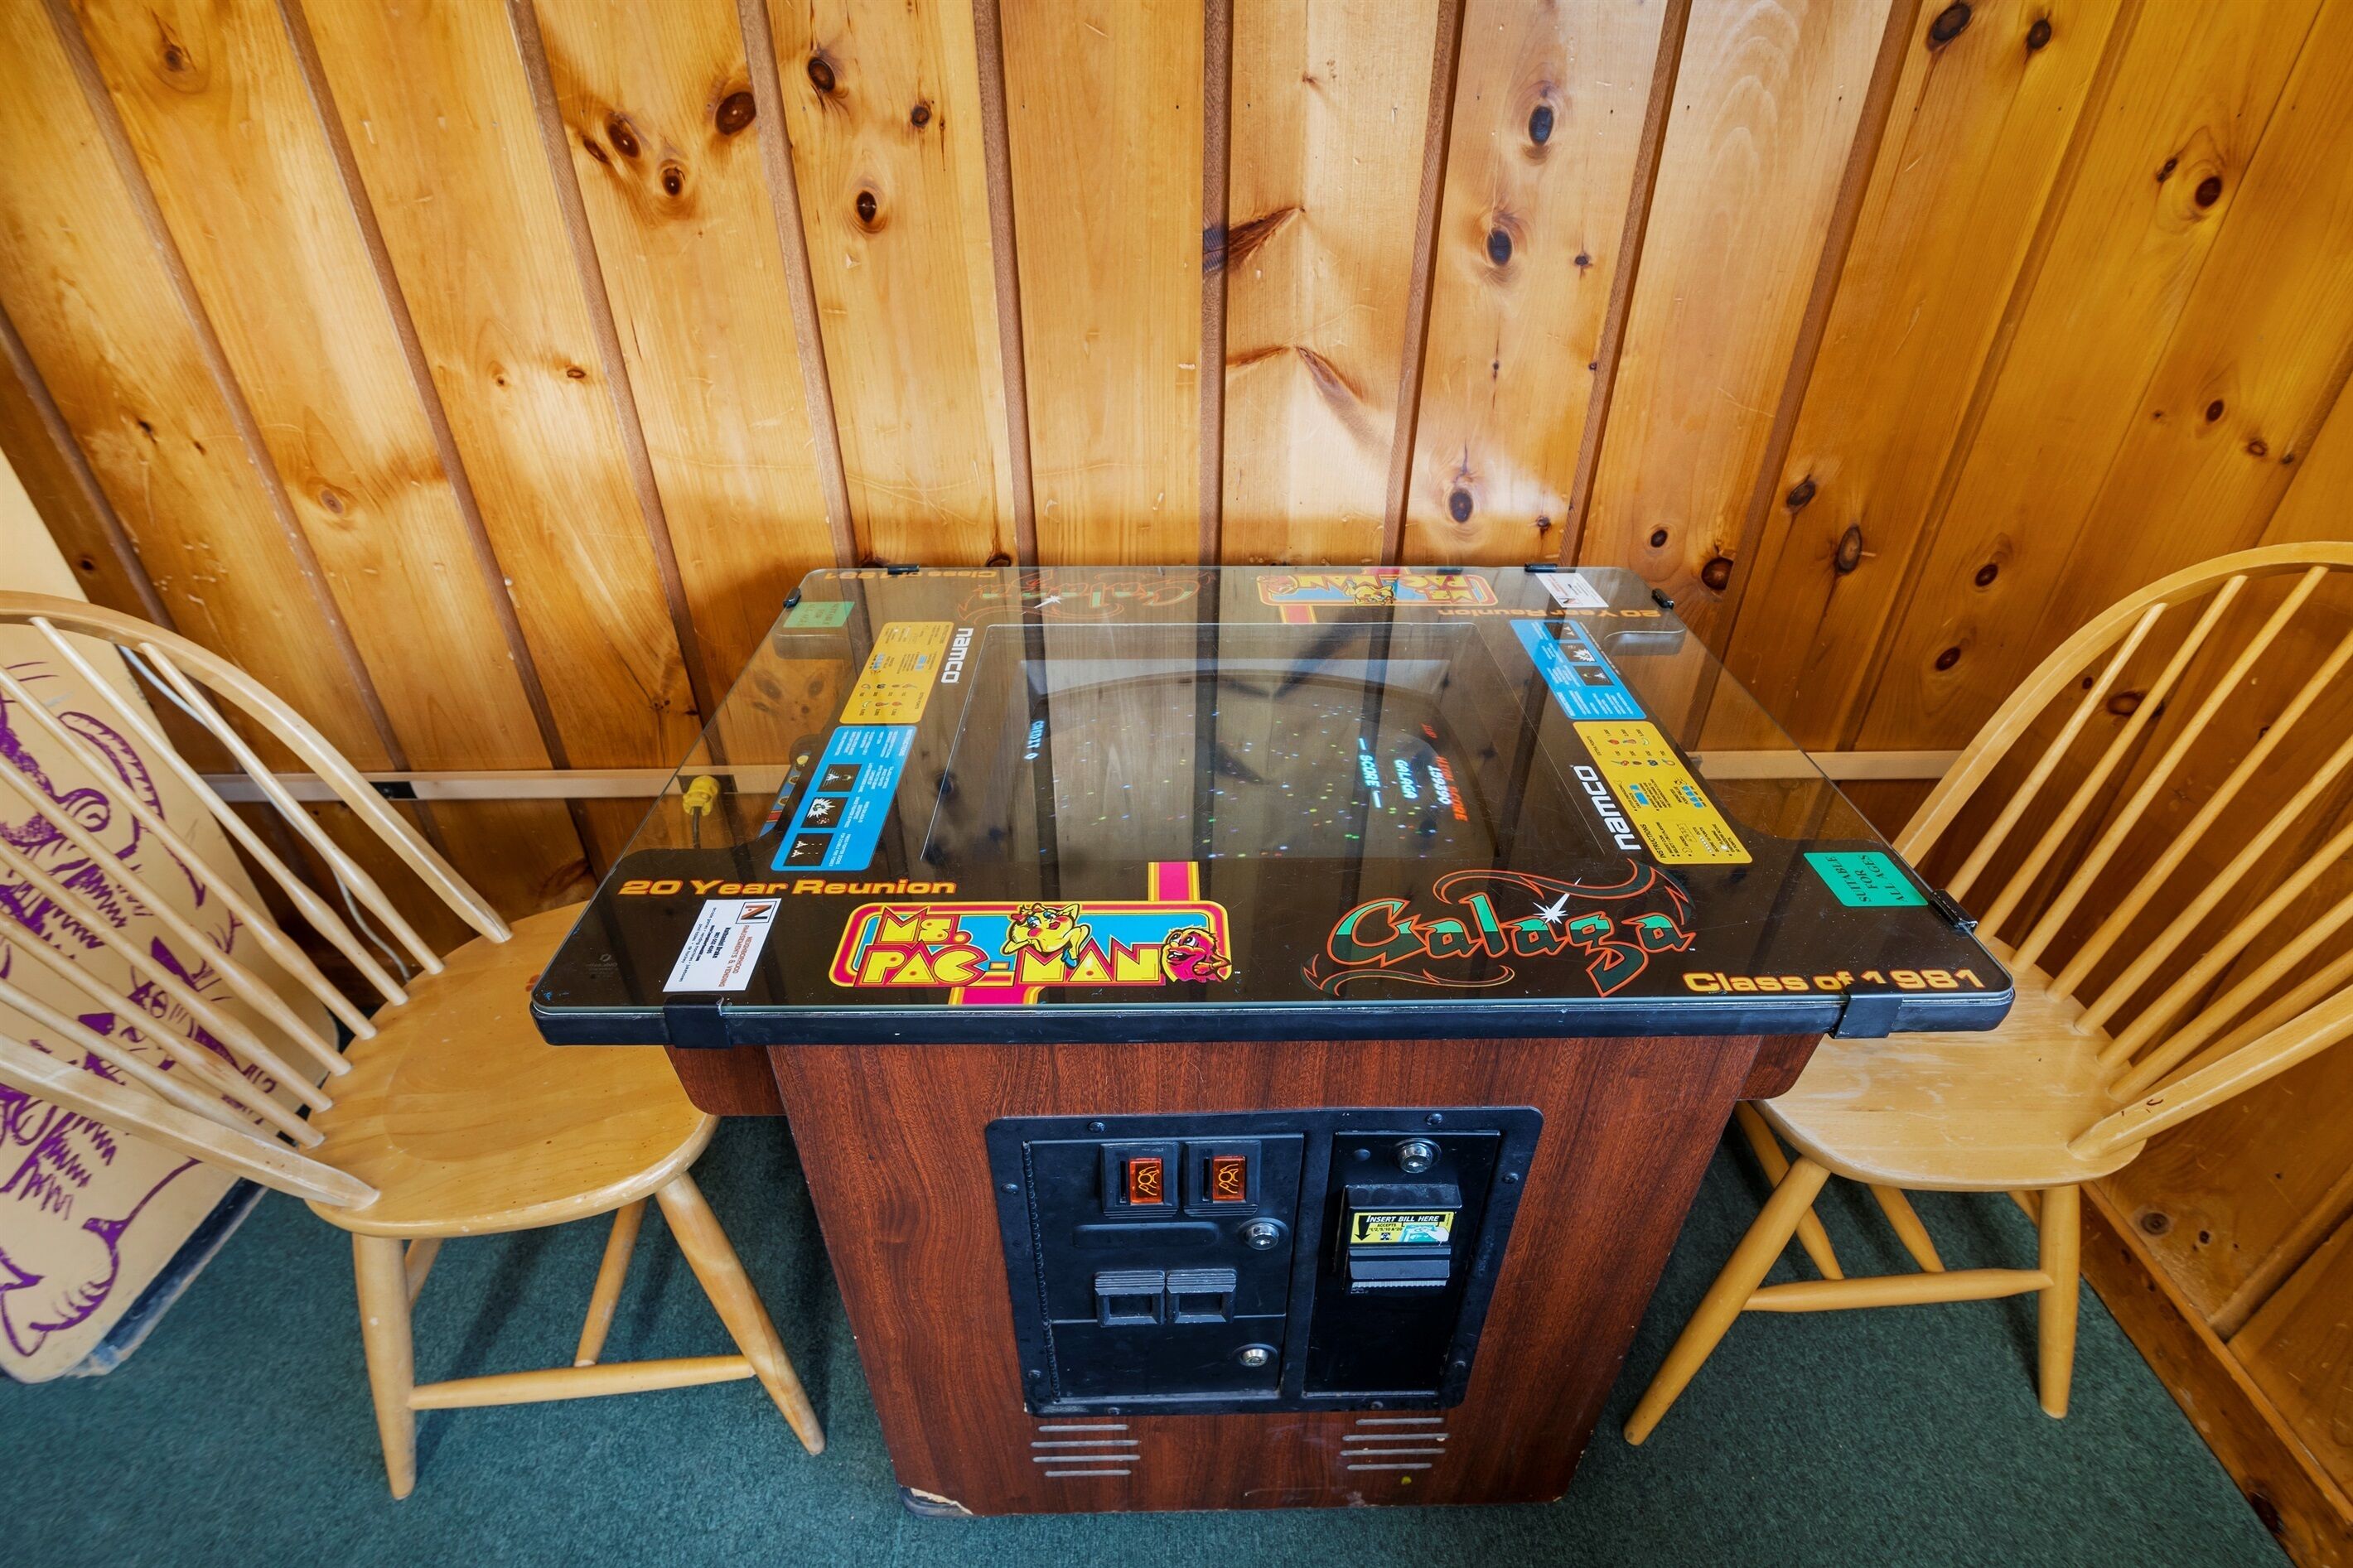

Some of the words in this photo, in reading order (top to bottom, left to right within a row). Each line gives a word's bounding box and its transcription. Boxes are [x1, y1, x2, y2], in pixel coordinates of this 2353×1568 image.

[1438, 609, 1548, 617] Reunion
[1551, 610, 1617, 618] Year
[1620, 610, 1661, 618] 20
[941, 628, 974, 683] namco
[1027, 721, 1045, 748] CREDIT
[1359, 755, 1380, 787] SCORE
[1394, 760, 1418, 799] GALAGA
[1436, 755, 1454, 781] HIGH
[1448, 785, 1468, 822] SCORE
[1573, 765, 1642, 851] namco
[1640, 823, 1666, 857] INSTRUCTIONS
[1825, 856, 1871, 902] SUITABLE
[1855, 870, 1878, 890] FOR
[1858, 855, 1887, 879] AGES
[617, 880, 682, 895] 20
[689, 880, 789, 895] Year
[791, 879, 957, 895] Reunion
[1884, 884, 1907, 902] ALL
[732, 925, 749, 958] AMUSEMENTS
[732, 937, 752, 974] NEIGHBORHOOD
[1327, 892, 1697, 997] Galaga
[718, 966, 732, 987] VENDING
[853, 938, 1166, 987] PAC-MAN
[1683, 972, 1809, 991] Class
[1813, 970, 1854, 991] of
[1861, 968, 1987, 990] 1981
